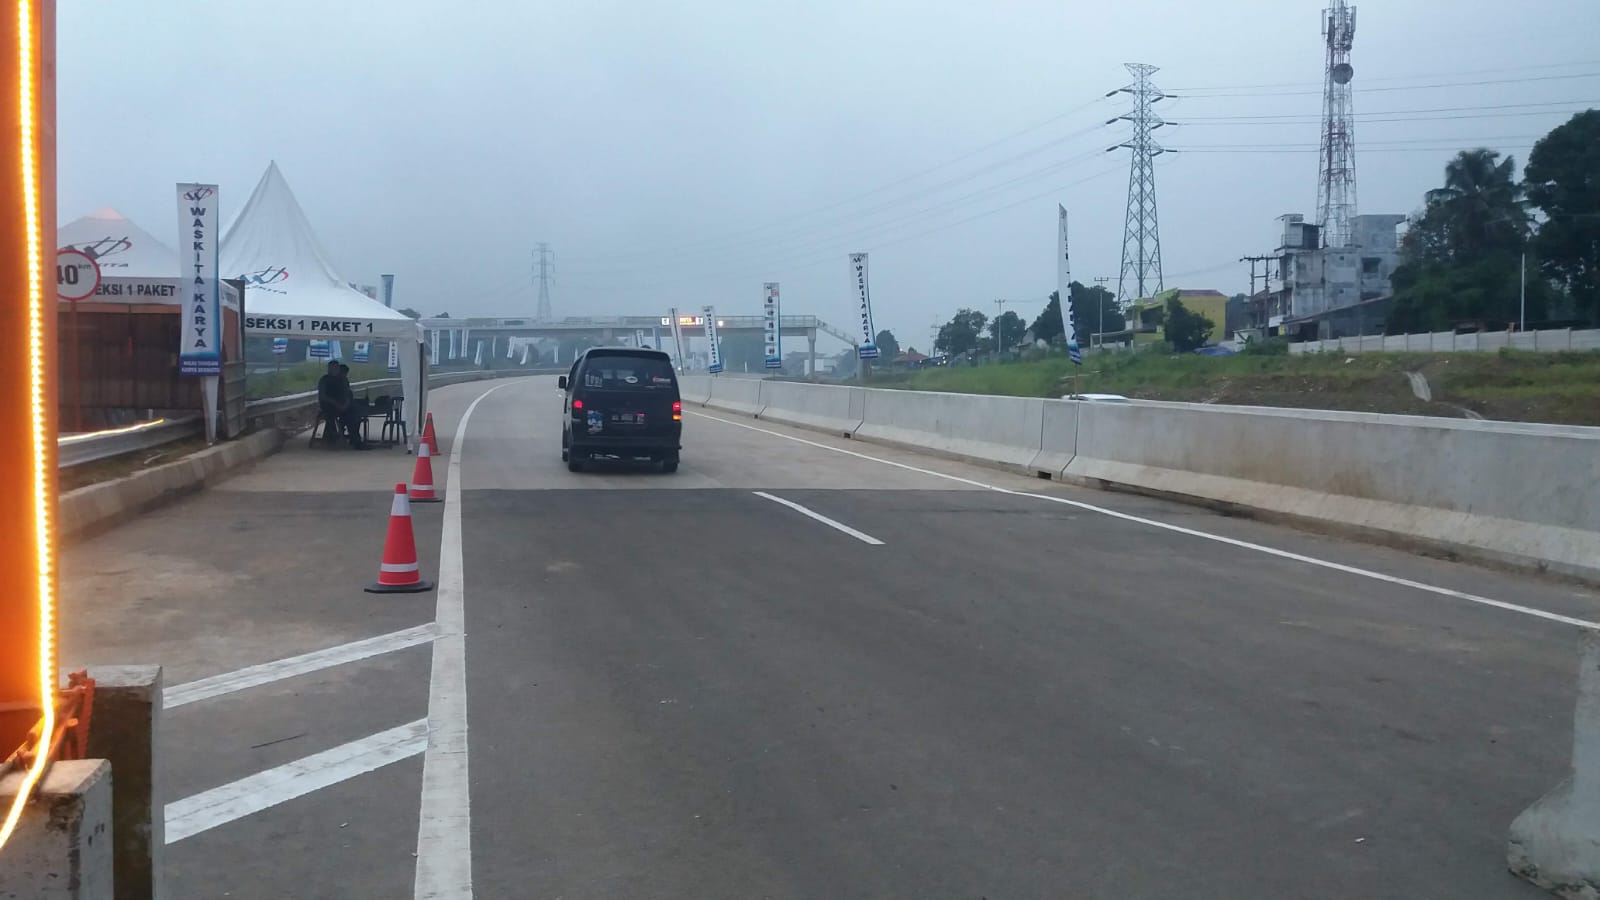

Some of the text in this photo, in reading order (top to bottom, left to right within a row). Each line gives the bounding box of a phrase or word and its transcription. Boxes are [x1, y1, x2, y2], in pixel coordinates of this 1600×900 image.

[190, 207, 206, 285] WASKITA
[95, 284, 123, 296] EKSI
[127, 285, 133, 296] 1
[137, 285, 175, 297] PAKET
[193, 293, 207, 348] KARYA
[245, 318, 374, 333] SEKSI 1 PAKET 1
